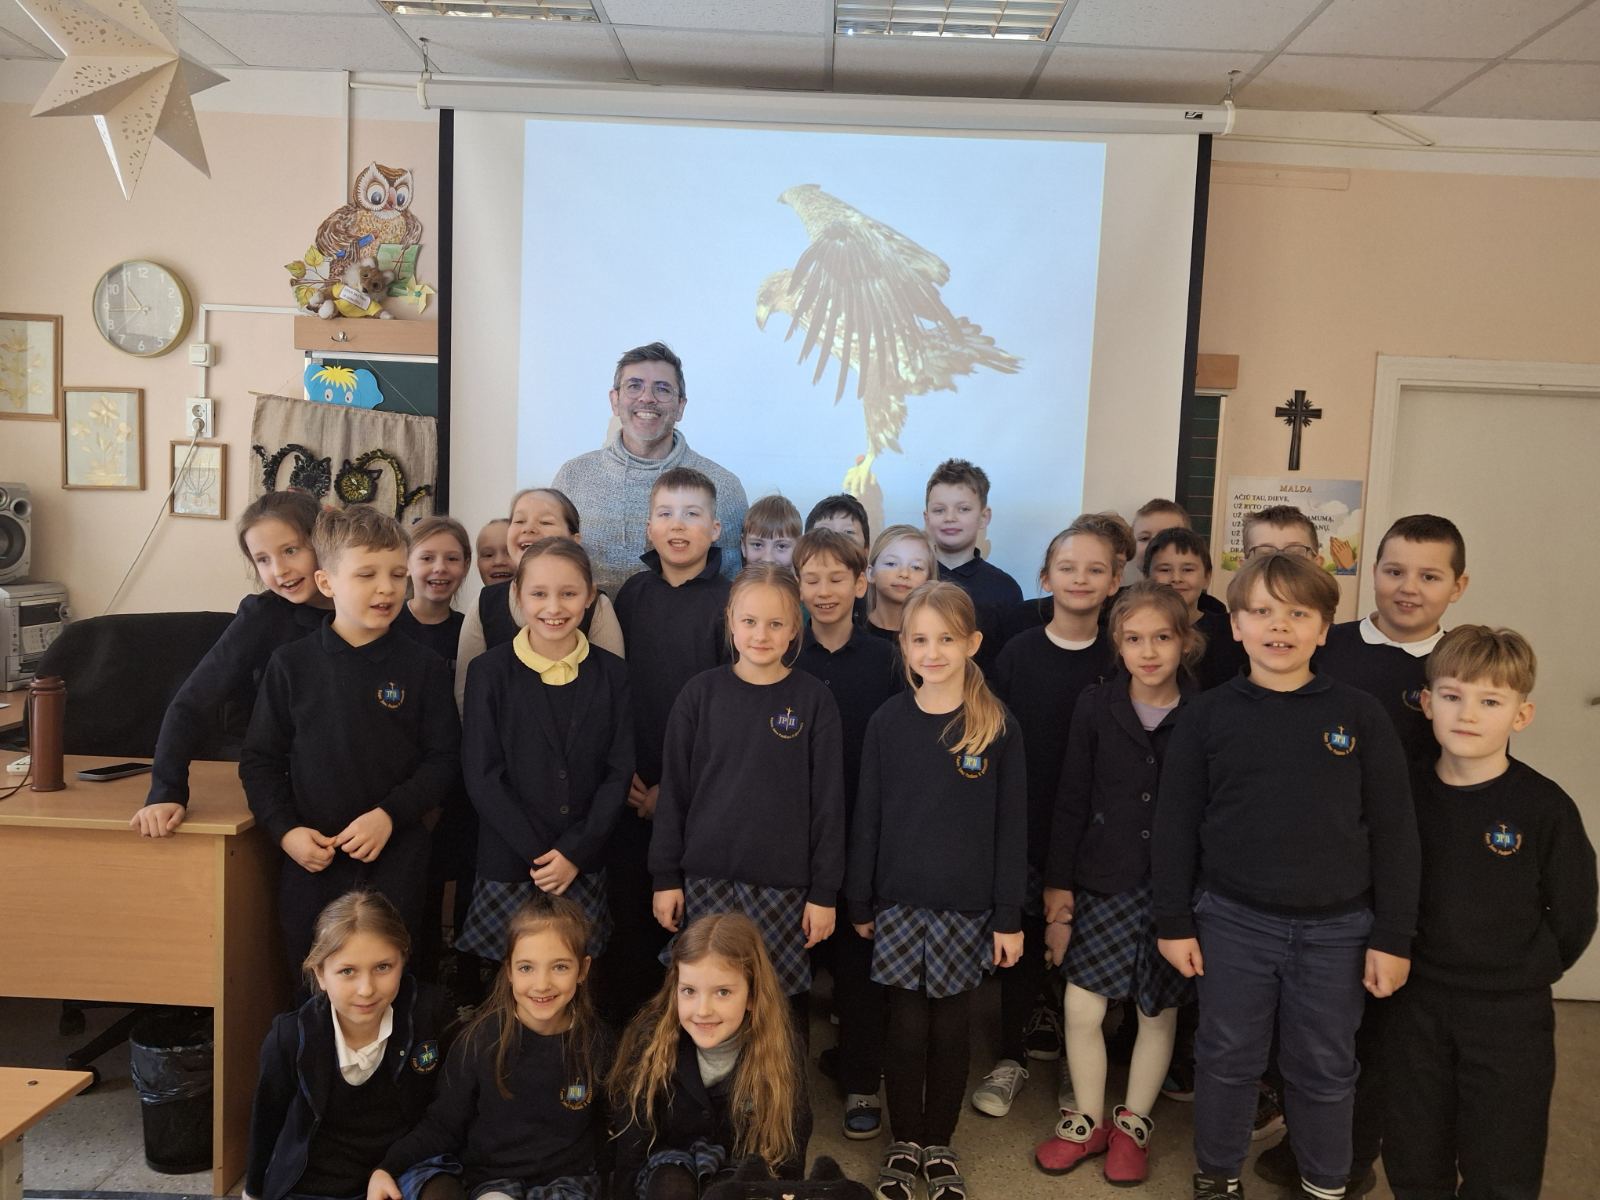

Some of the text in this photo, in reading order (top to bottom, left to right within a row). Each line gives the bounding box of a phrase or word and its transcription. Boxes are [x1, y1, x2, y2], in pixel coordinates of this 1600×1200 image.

[121, 271, 131, 282] 11
[137, 267, 149, 279] 12
[160, 273, 165, 283] 1
[108, 284, 119, 295] 10
[168, 287, 175, 298] 2
[174, 306, 181, 317] 3
[107, 319, 114, 330] 8
[119, 334, 126, 344] 7
[156, 337, 164, 347] 5
[138, 340, 145, 351] 6
[1280, 485, 1312, 493] MALDA
